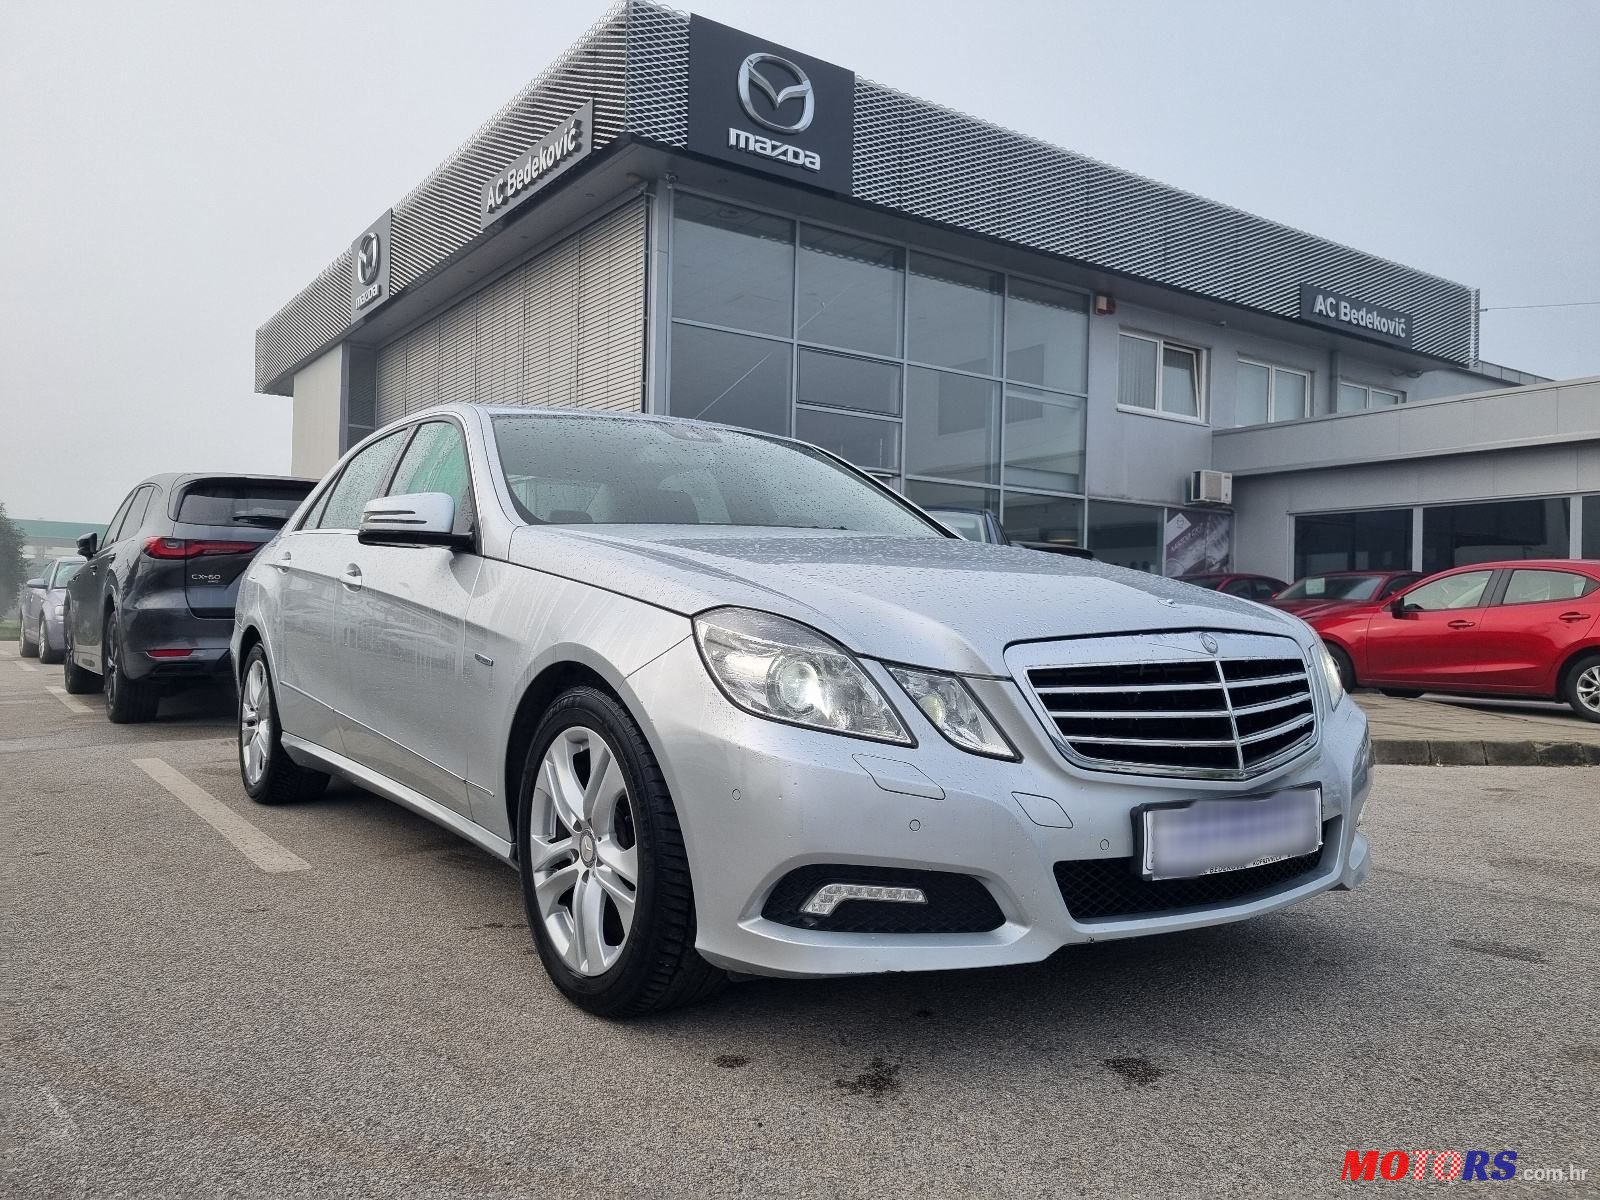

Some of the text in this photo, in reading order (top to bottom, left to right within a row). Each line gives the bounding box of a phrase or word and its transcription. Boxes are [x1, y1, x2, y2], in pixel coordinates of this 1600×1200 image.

[486, 119, 577, 213] AC Bedeković
[1313, 294, 1337, 318] AC
